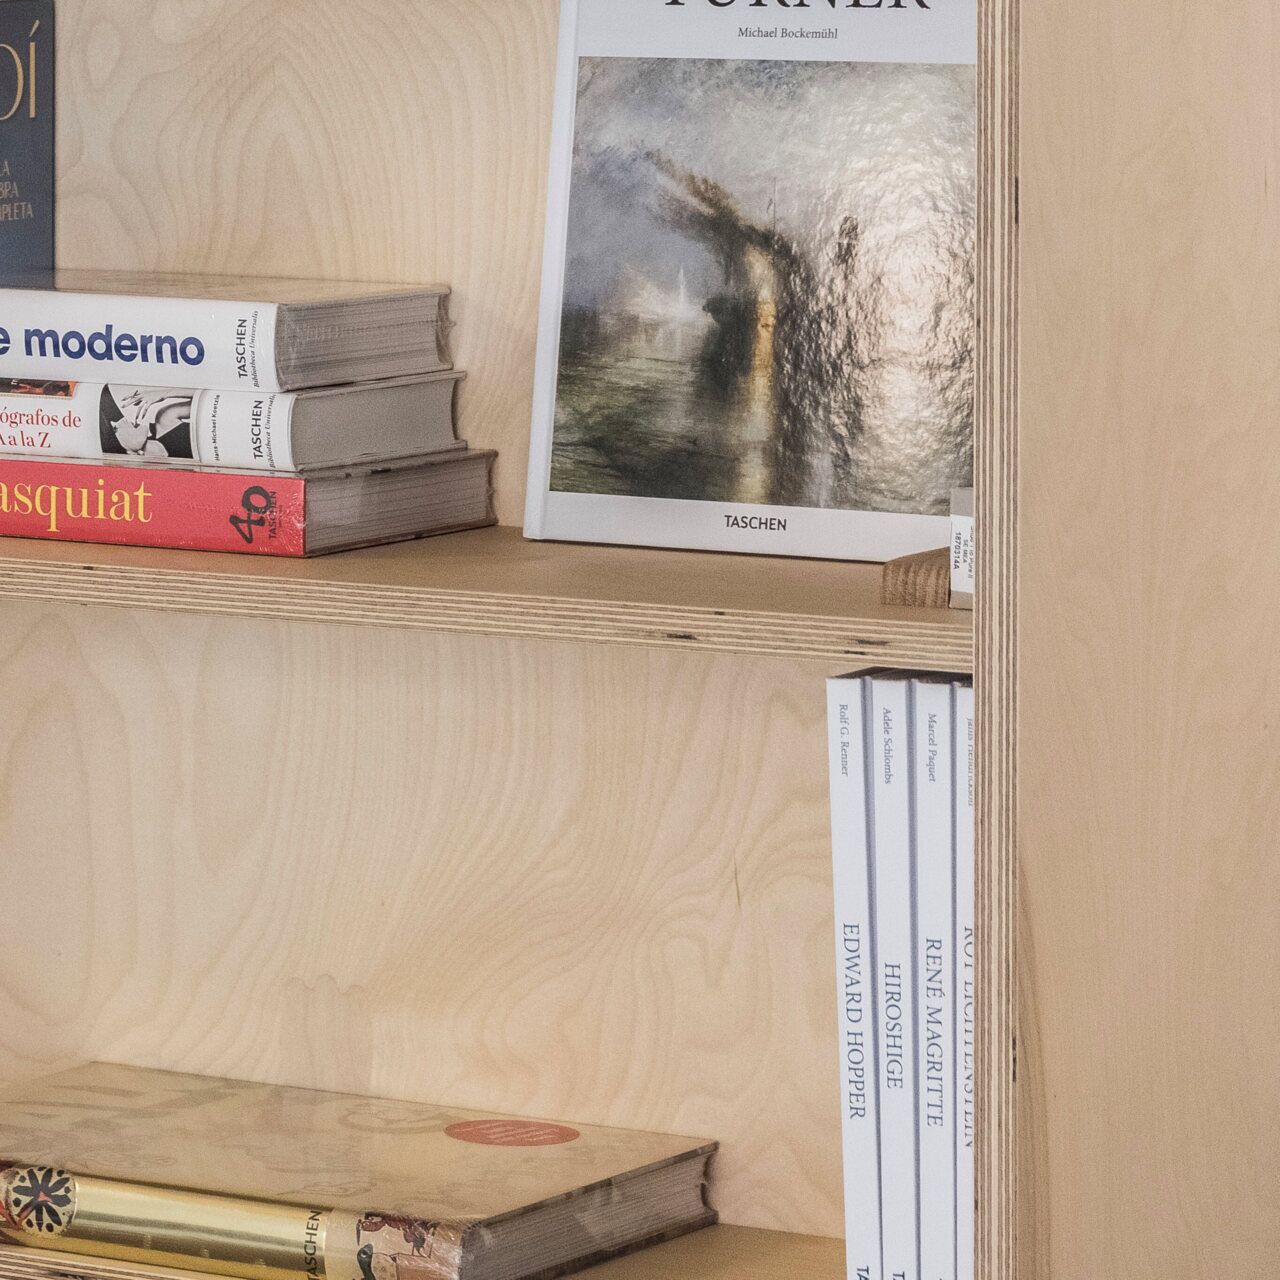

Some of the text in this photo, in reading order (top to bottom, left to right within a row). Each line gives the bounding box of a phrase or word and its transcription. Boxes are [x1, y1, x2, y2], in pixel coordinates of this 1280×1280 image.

[737, 26, 838, 40] Michael Bockemühl
[24, 323, 205, 367] moderno
[235, 319, 248, 379] TASCHEN
[8, 435, 17, 446] a
[20, 430, 36, 447] la
[38, 432, 51, 448] Z
[62, 410, 81, 428] de
[251, 400, 264, 460] TASCHEN
[229, 485, 271, 544] 40
[269, 491, 277, 540] TASCHEN
[724, 514, 787, 532] TASCHEN
[839, 704, 850, 777] Rolf G. Renner
[883, 707, 893, 785] Adele Schlombs
[926, 712, 937, 783] Marcel Paquet
[843, 923, 866, 1120] EDWARD HOPPER
[884, 962, 903, 1089] HIROSHIGE
[926, 937, 945, 1127] RENÉ MAGRITTE
